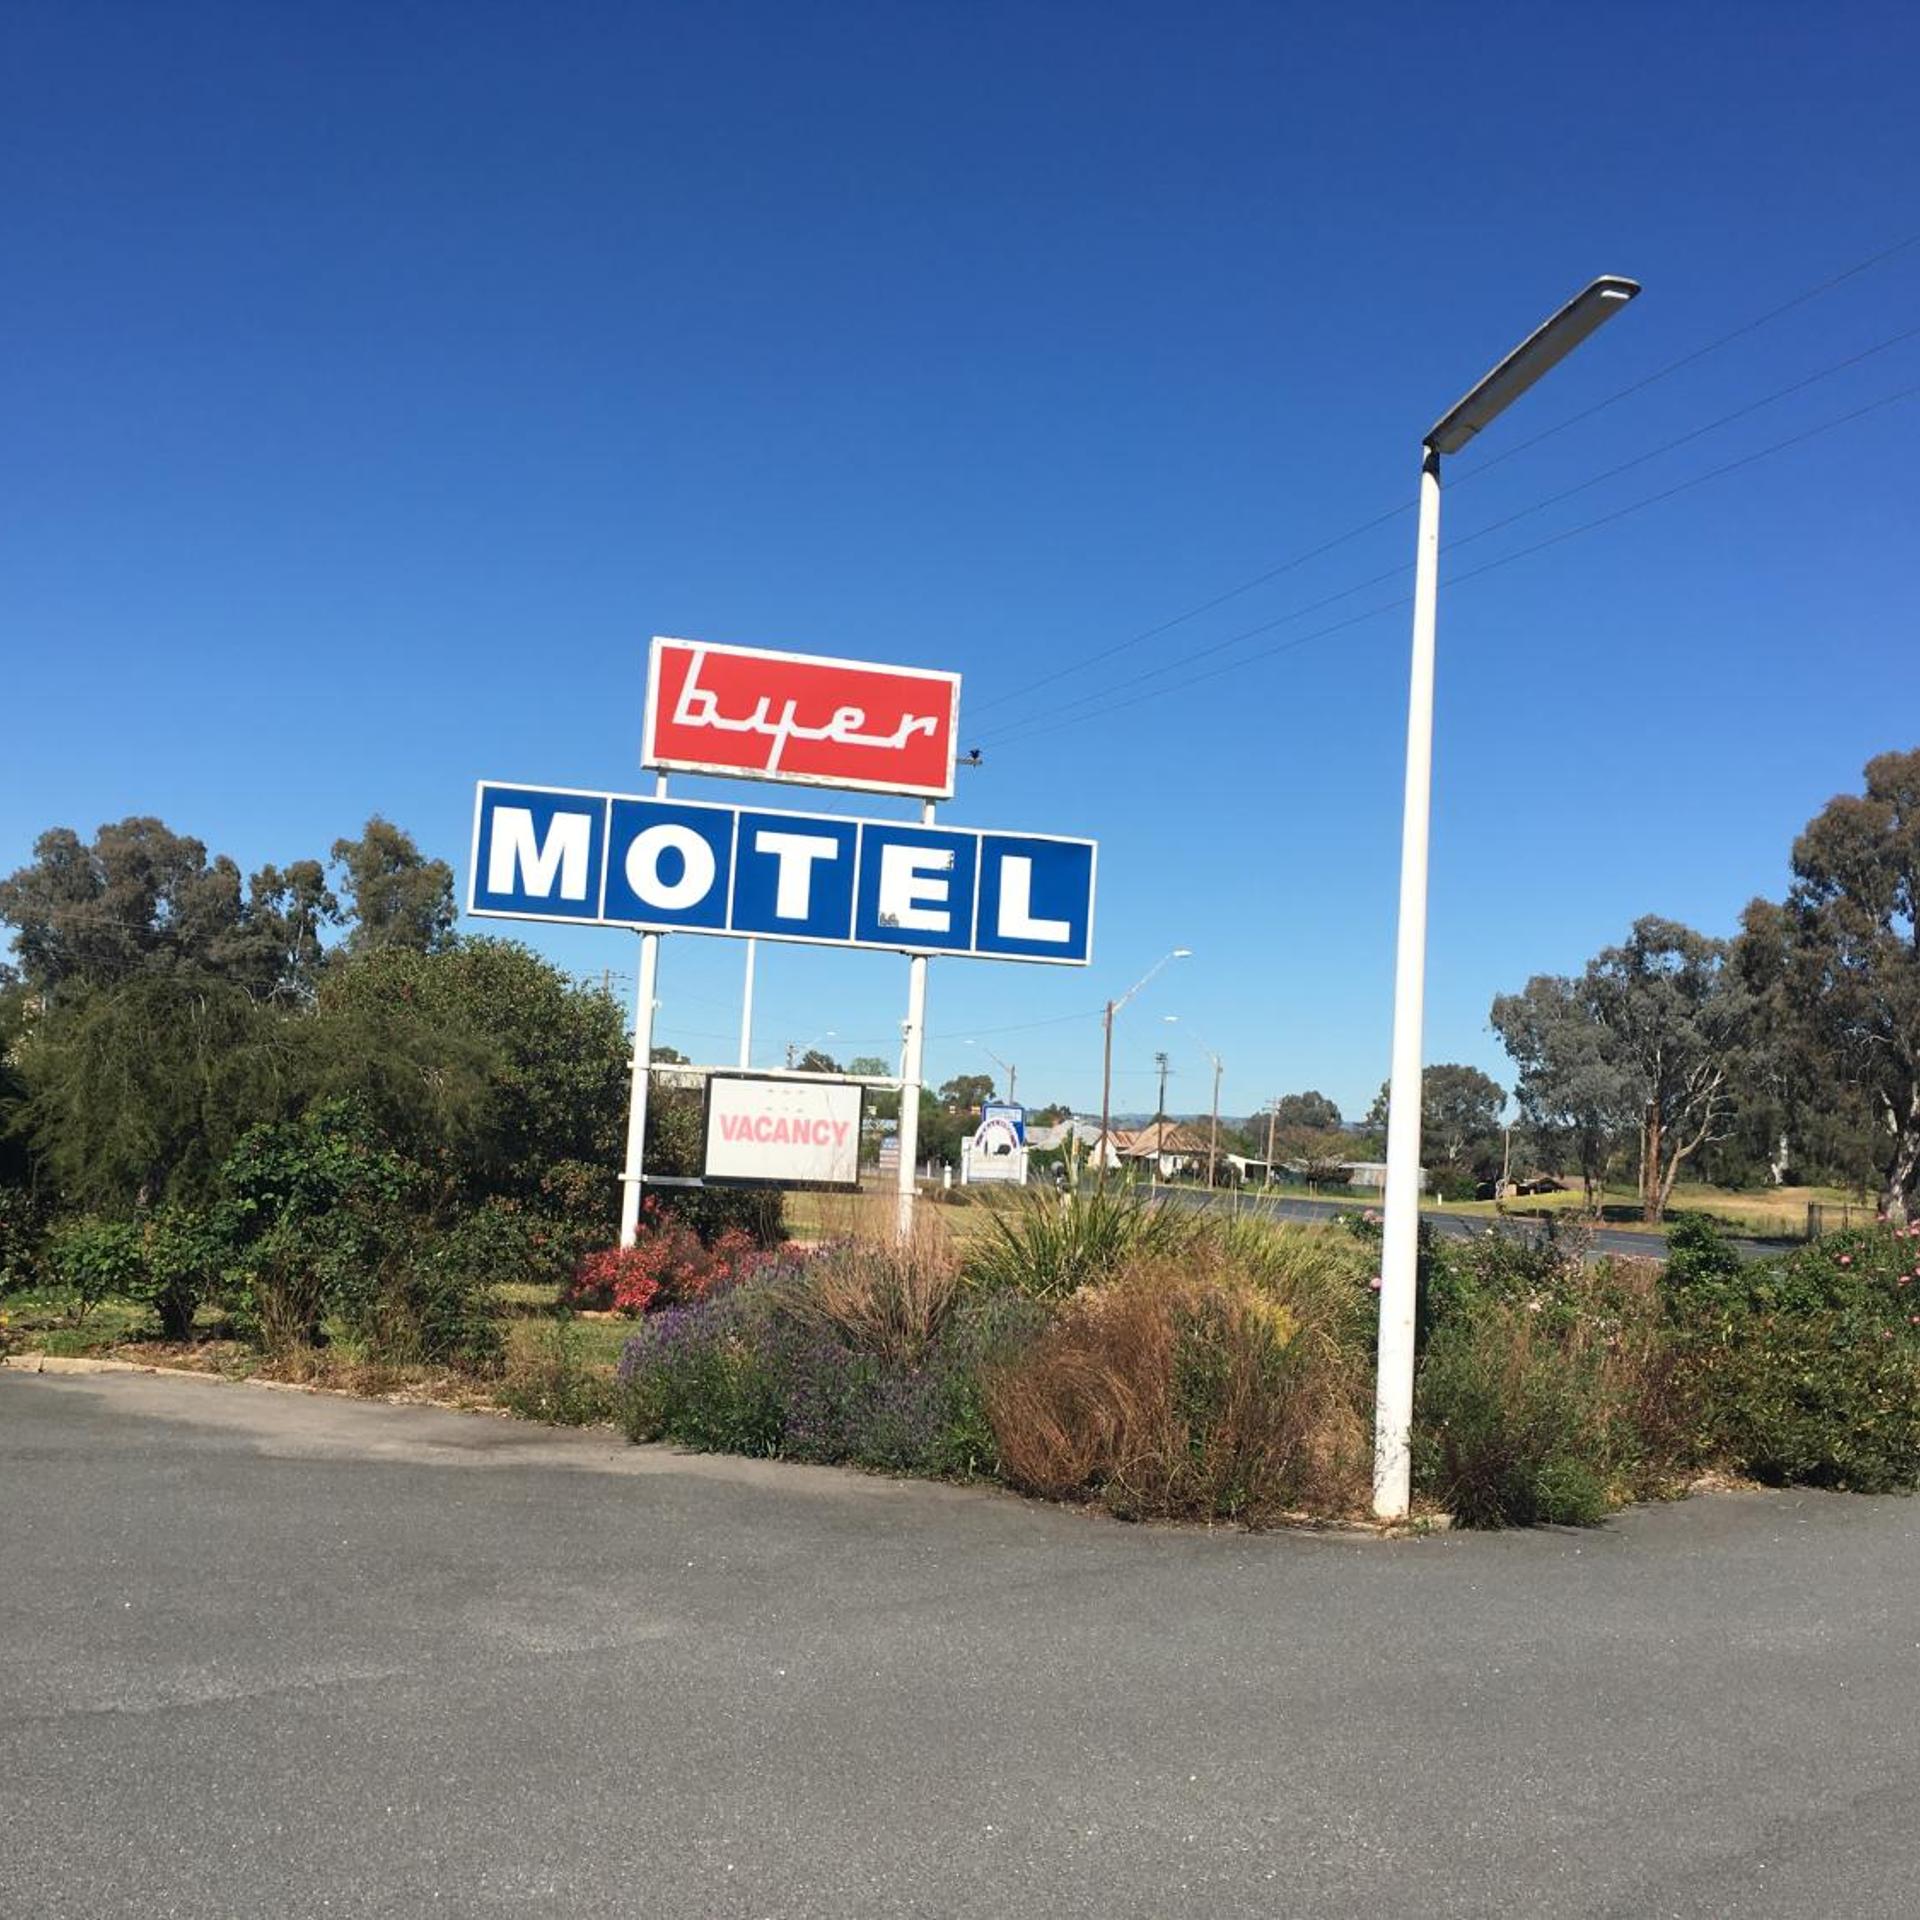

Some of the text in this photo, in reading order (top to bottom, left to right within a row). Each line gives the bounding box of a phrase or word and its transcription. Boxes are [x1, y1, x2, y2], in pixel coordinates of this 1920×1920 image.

[671, 650, 938, 772] byer
[488, 807, 1070, 942] MOTEL
[719, 1114, 850, 1147] VACANCY
